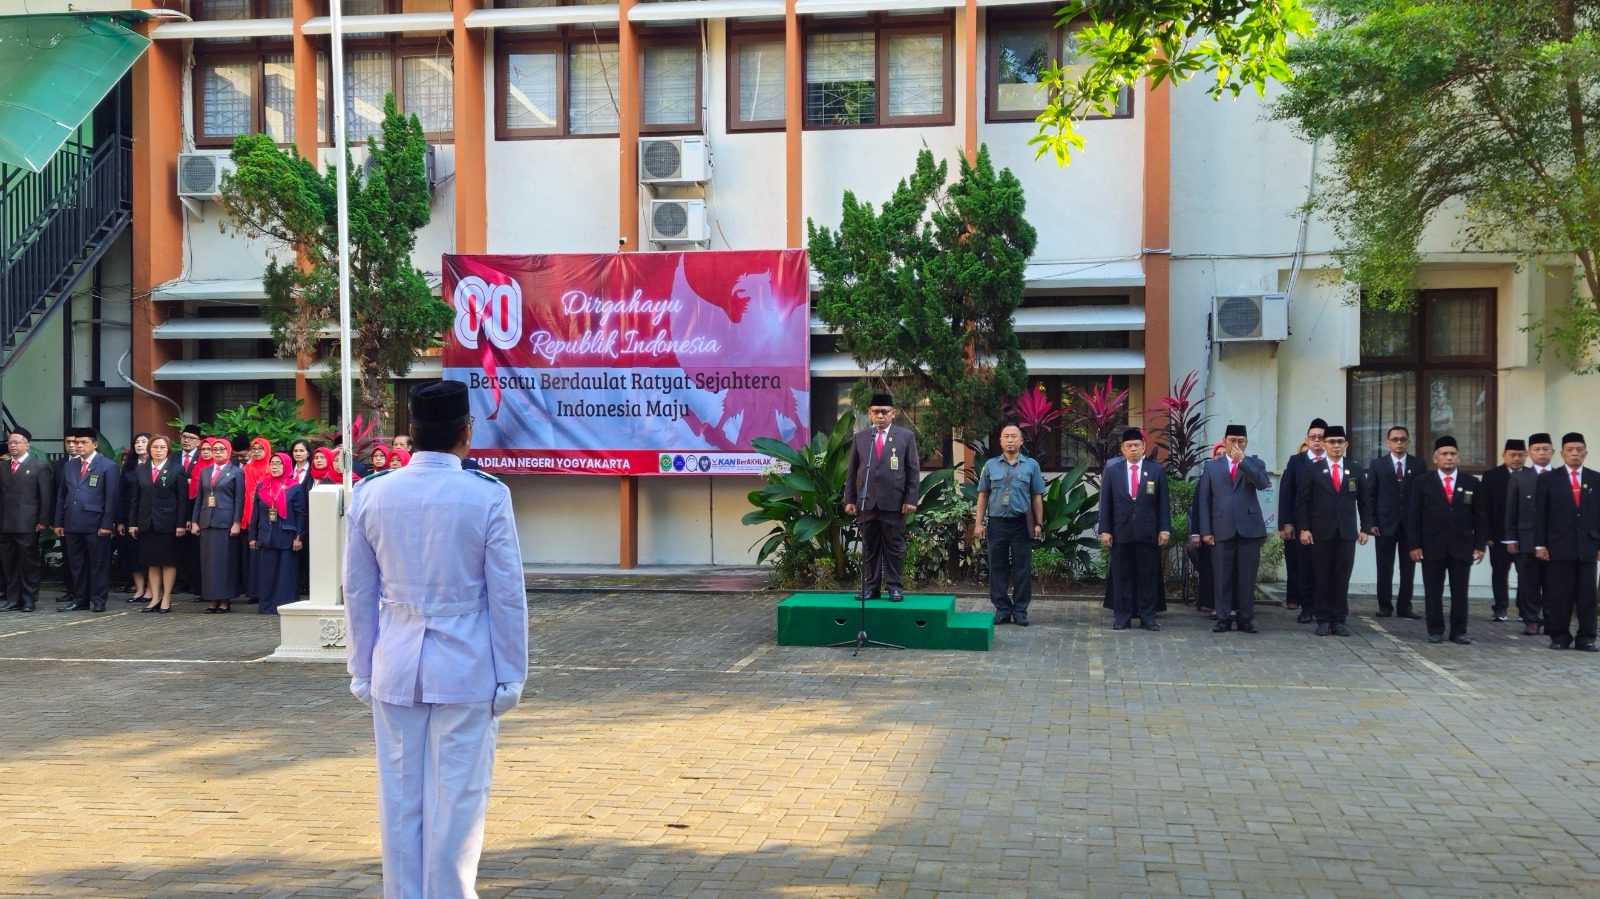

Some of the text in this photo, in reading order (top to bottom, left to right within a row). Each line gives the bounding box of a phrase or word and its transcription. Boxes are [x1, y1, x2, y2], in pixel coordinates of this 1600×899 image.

[454, 275, 523, 350] 80
[561, 288, 683, 325] Dirgahayu
[529, 329, 721, 365] Republik Indonesia
[469, 371, 781, 394] Bersatu Berdaulat Ratyat Sejahtera
[556, 400, 690, 422] Indonesia Maju
[470, 457, 631, 469] ADILAN NEGERI YOGYAKARTA
[737, 458, 771, 466] BerAKHLAK
